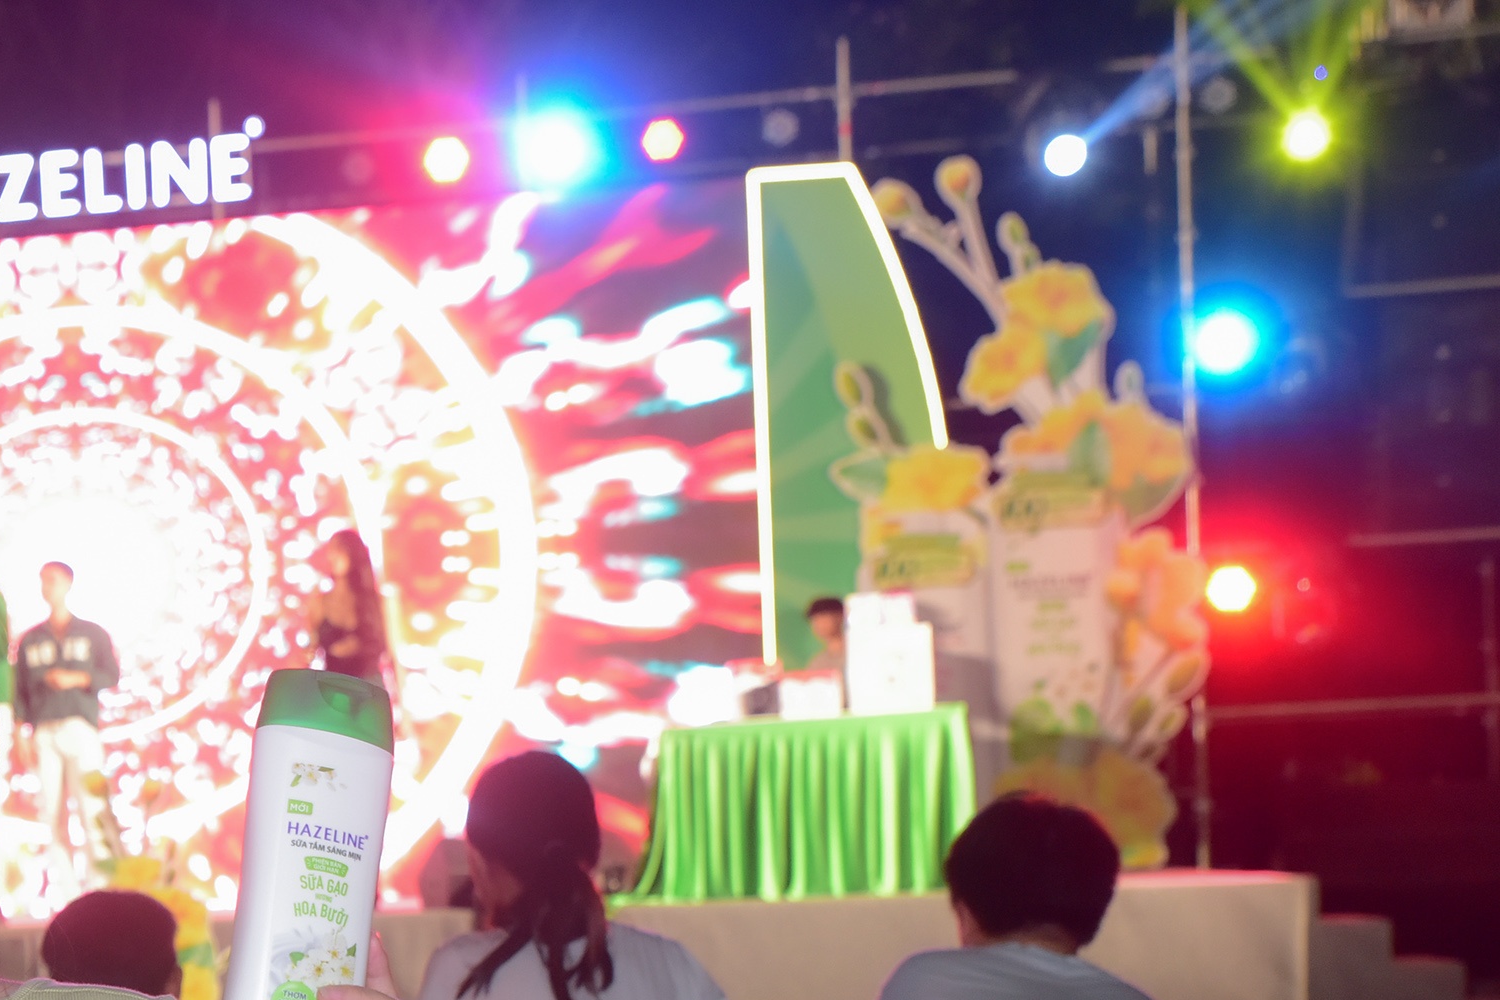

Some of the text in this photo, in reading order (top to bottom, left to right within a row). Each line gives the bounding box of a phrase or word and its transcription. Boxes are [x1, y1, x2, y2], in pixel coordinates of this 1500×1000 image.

[289, 802, 309, 813] MỚI
[287, 821, 366, 850] HAZELINE
[291, 839, 307, 848] SỮA
[326, 845, 347, 857] SÁNG
[347, 851, 362, 862] MỊN
[300, 873, 349, 898] SỮA GẠO
[293, 901, 349, 927] HOA BƯỞI
[283, 990, 307, 1000] THƠM
